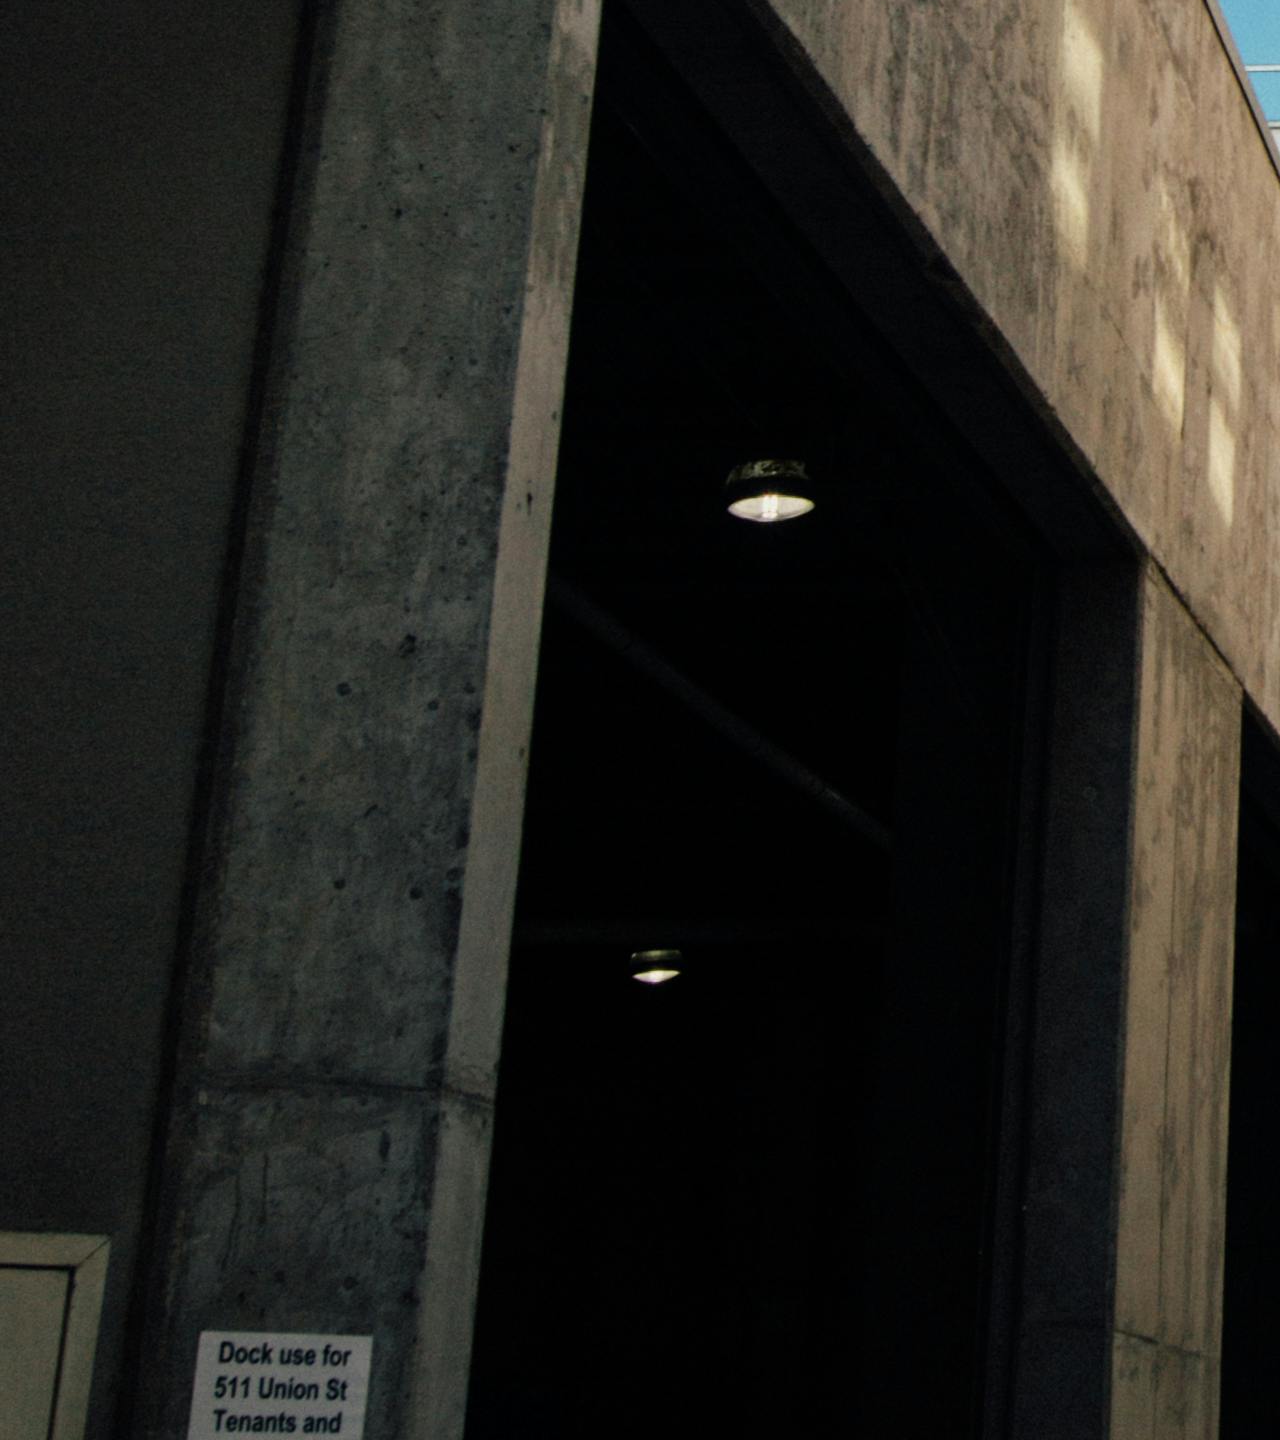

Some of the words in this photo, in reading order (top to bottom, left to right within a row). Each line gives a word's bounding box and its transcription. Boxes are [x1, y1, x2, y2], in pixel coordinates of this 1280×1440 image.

[218, 1341, 272, 1365] Dock
[280, 1348, 316, 1365] use
[322, 1344, 352, 1366] for
[214, 1375, 250, 1399] 511
[258, 1377, 319, 1399] Union
[325, 1378, 348, 1401] St
[213, 1409, 296, 1432] Tenants
[303, 1412, 342, 1433] and
